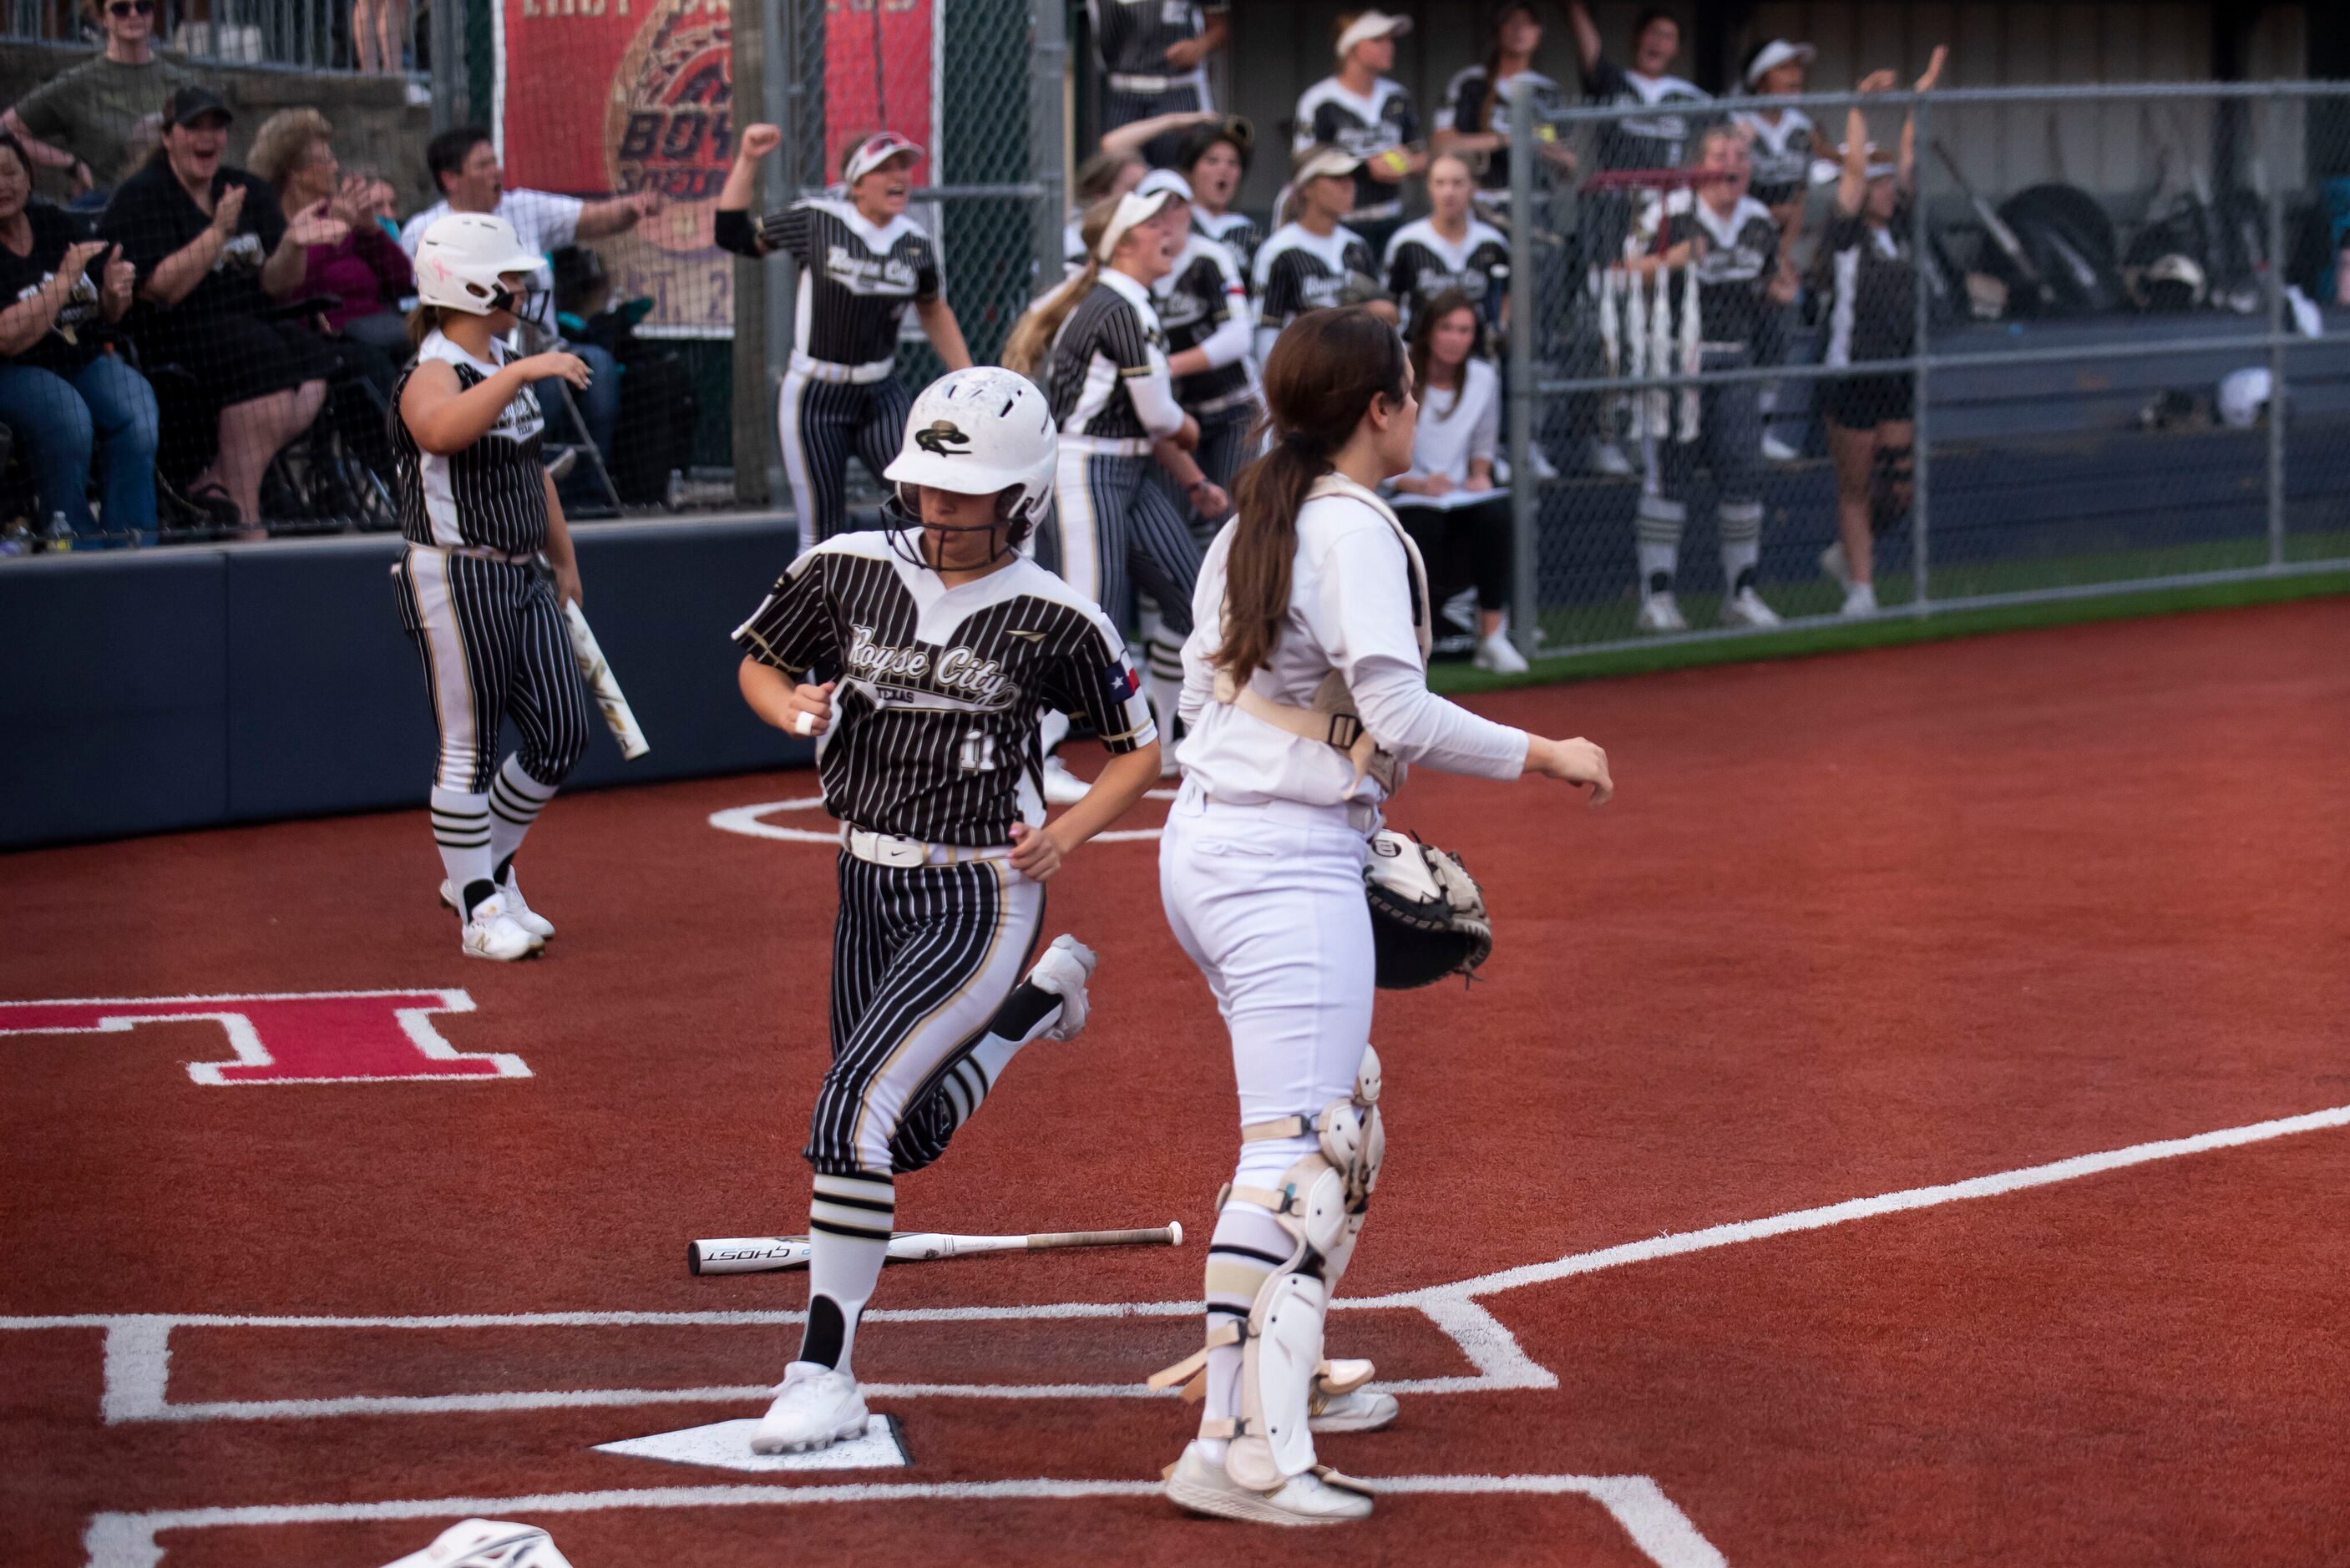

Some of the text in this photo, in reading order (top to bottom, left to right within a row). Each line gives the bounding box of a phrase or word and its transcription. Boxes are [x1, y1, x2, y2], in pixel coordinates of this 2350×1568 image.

[849, 624, 1010, 706] Royse City
[874, 686, 915, 704] TEXAS
[701, 1246, 791, 1262] GHOST
